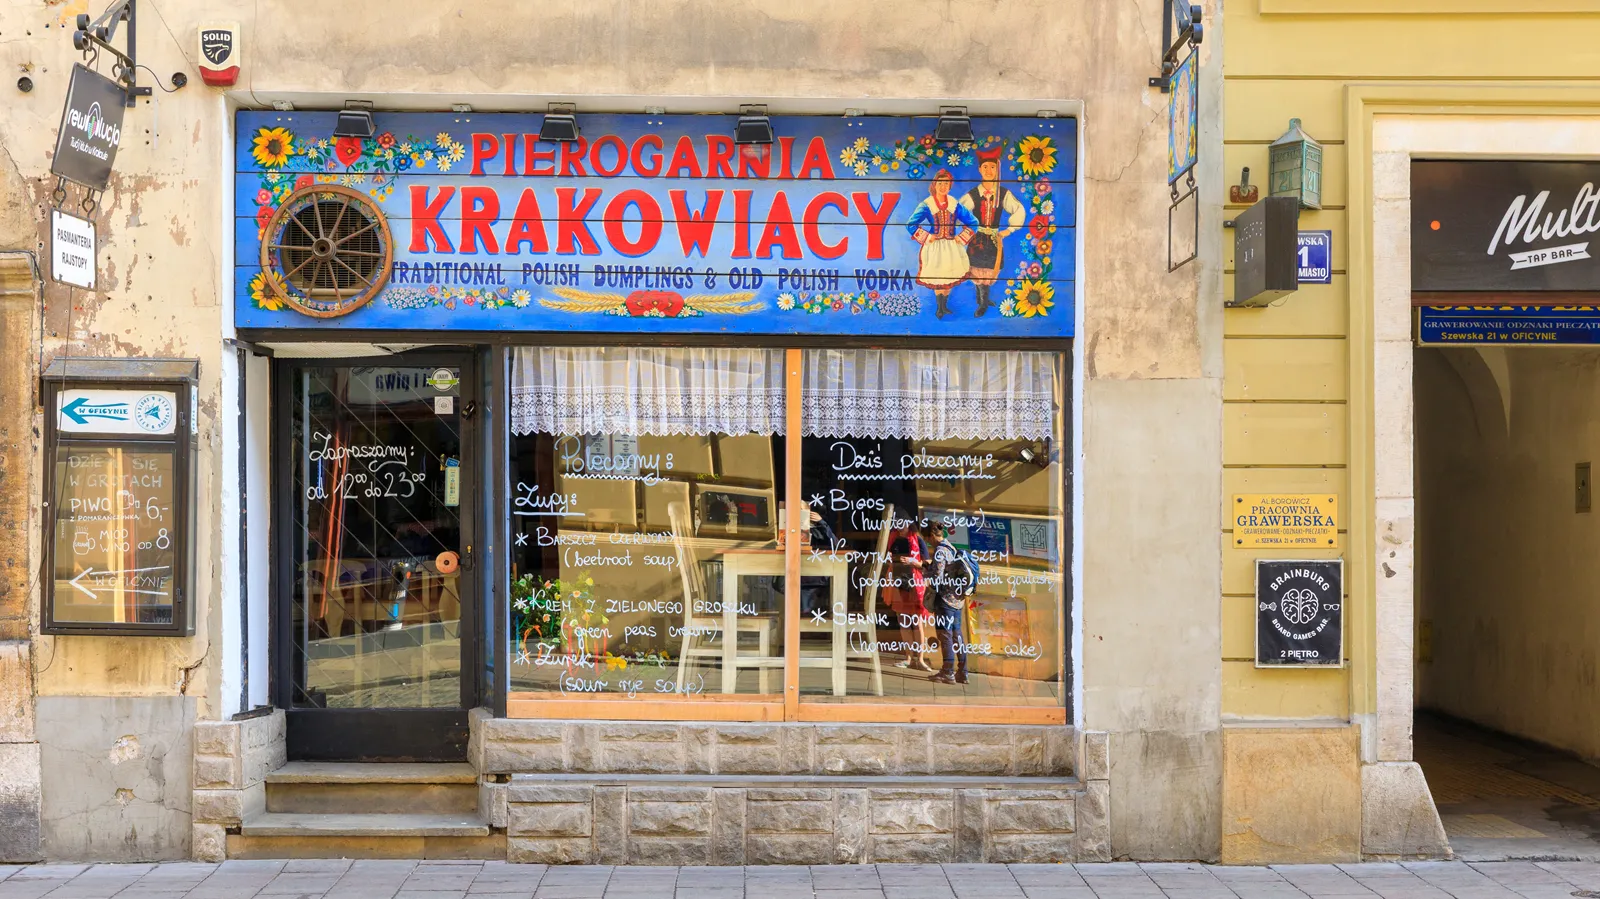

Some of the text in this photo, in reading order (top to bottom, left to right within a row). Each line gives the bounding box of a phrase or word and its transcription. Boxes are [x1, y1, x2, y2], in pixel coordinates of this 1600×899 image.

[203, 33, 231, 42] SOLID
[469, 132, 836, 179] PIEROGARNIA
[408, 185, 901, 261] KRAKOWIACY
[57, 228, 92, 250] PASMANTERIA
[61, 251, 88, 270] RAJSTOPY
[1528, 249, 1573, 264] TAP BAR
[391, 261, 914, 291] TRADITIONAL POLISH DUMPLINGS & OLD POLISH VODKA
[1424, 321, 1504, 329] GRAWEROWANIE
[1507, 321, 1552, 329] ODZNAKI
[1441, 332, 1484, 340] Szewska
[1487, 332, 1496, 340] 21
[1511, 332, 1557, 340] OFICYNIE
[309, 431, 414, 472] Zapraszamy:
[554, 434, 674, 486] Polecamy:
[830, 441, 993, 478] Dziś polecamy:
[307, 476, 329, 500] od
[365, 482, 381, 498] do
[514, 482, 577, 516] Zupy:
[70, 497, 111, 513] PIWO
[1252, 506, 1320, 514] PRACOWNIA
[943, 508, 986, 532] stew)
[1237, 515, 1335, 526] GRAWERSKA
[100, 541, 129, 553] WINO
[156, 528, 170, 549] 8
[565, 548, 683, 571] (beetroot soup)
[95, 576, 168, 588] W OFICYNIE
[851, 567, 903, 596] (potato
[977, 568, 1003, 585] with
[1270, 568, 1330, 591] BRAINBURG
[606, 600, 682, 614] ZIELONEGO
[693, 600, 758, 615] GROSZKU
[561, 616, 718, 650] (green peas cream)
[1272, 618, 1328, 640] BOARD GAMES BAR
[850, 628, 1043, 662] (homemade cheese cake)
[1280, 650, 1319, 659] 2 PIĘTRO
[559, 670, 704, 699] (sour rye soup)
